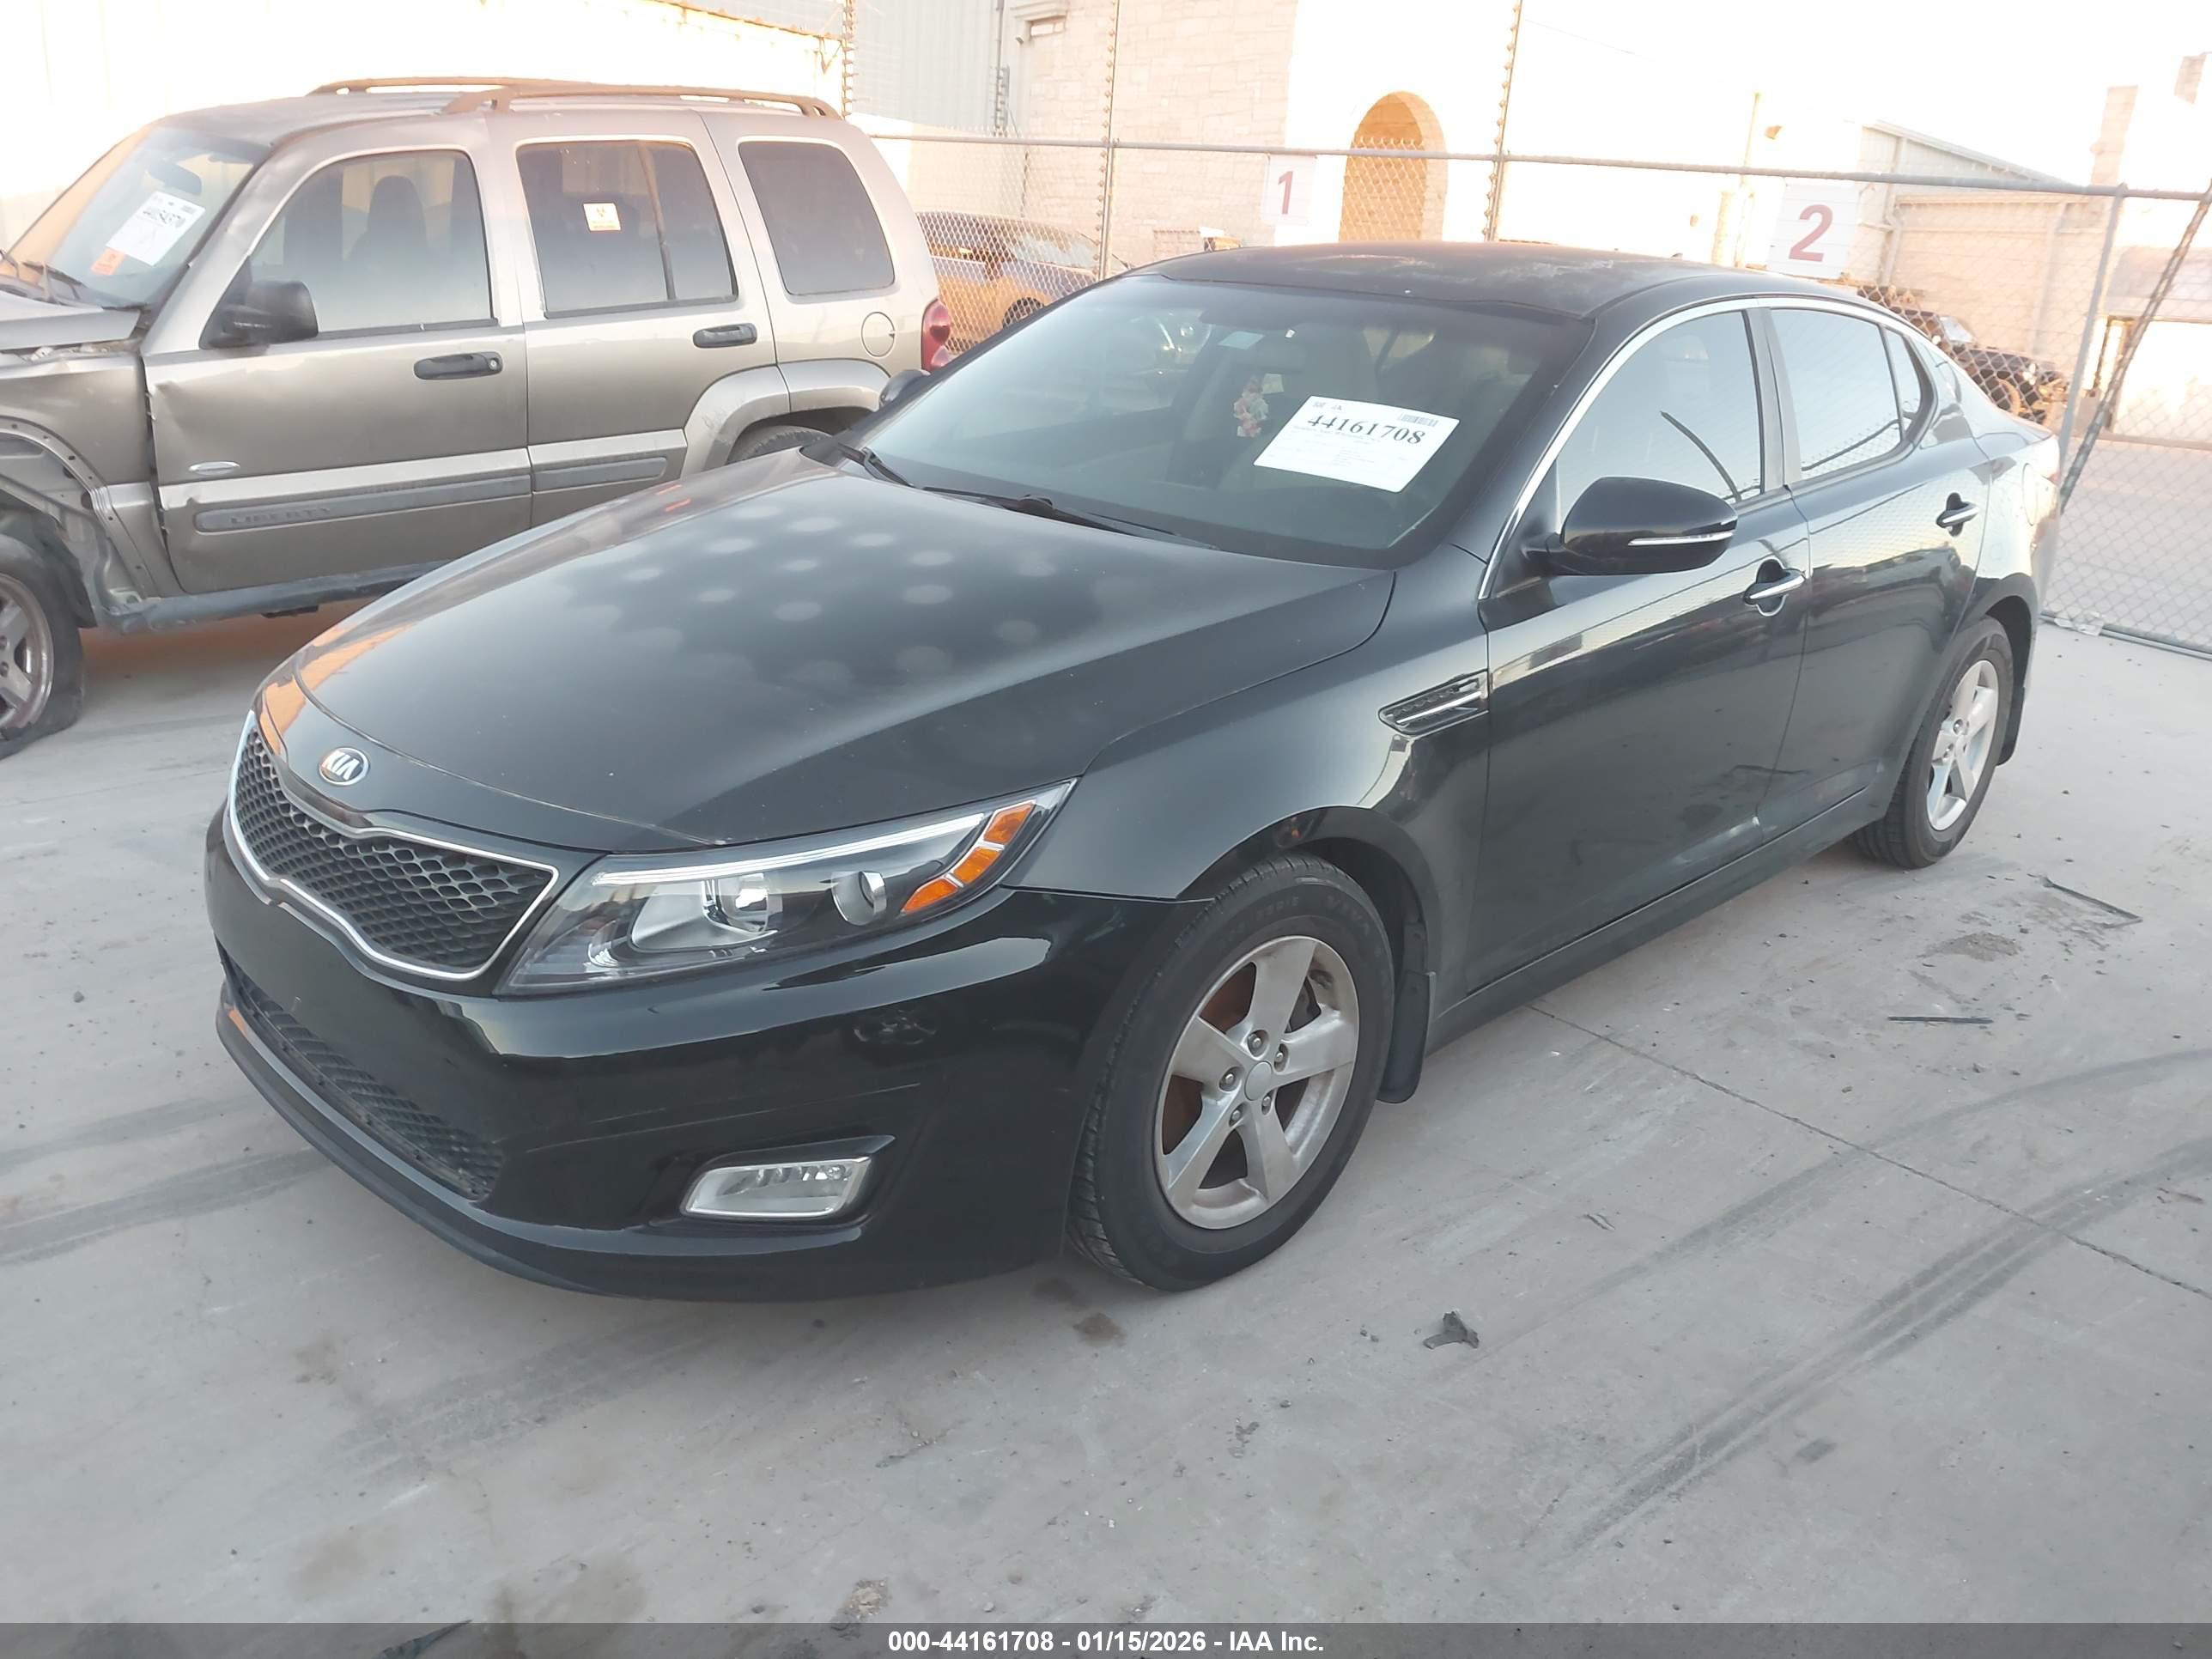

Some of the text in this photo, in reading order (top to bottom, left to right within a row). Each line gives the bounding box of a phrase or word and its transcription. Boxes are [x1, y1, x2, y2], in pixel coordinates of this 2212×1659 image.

[1278, 171, 1293, 215] 1
[1789, 204, 1833, 262] 2
[1307, 414, 1426, 445] 44161708
